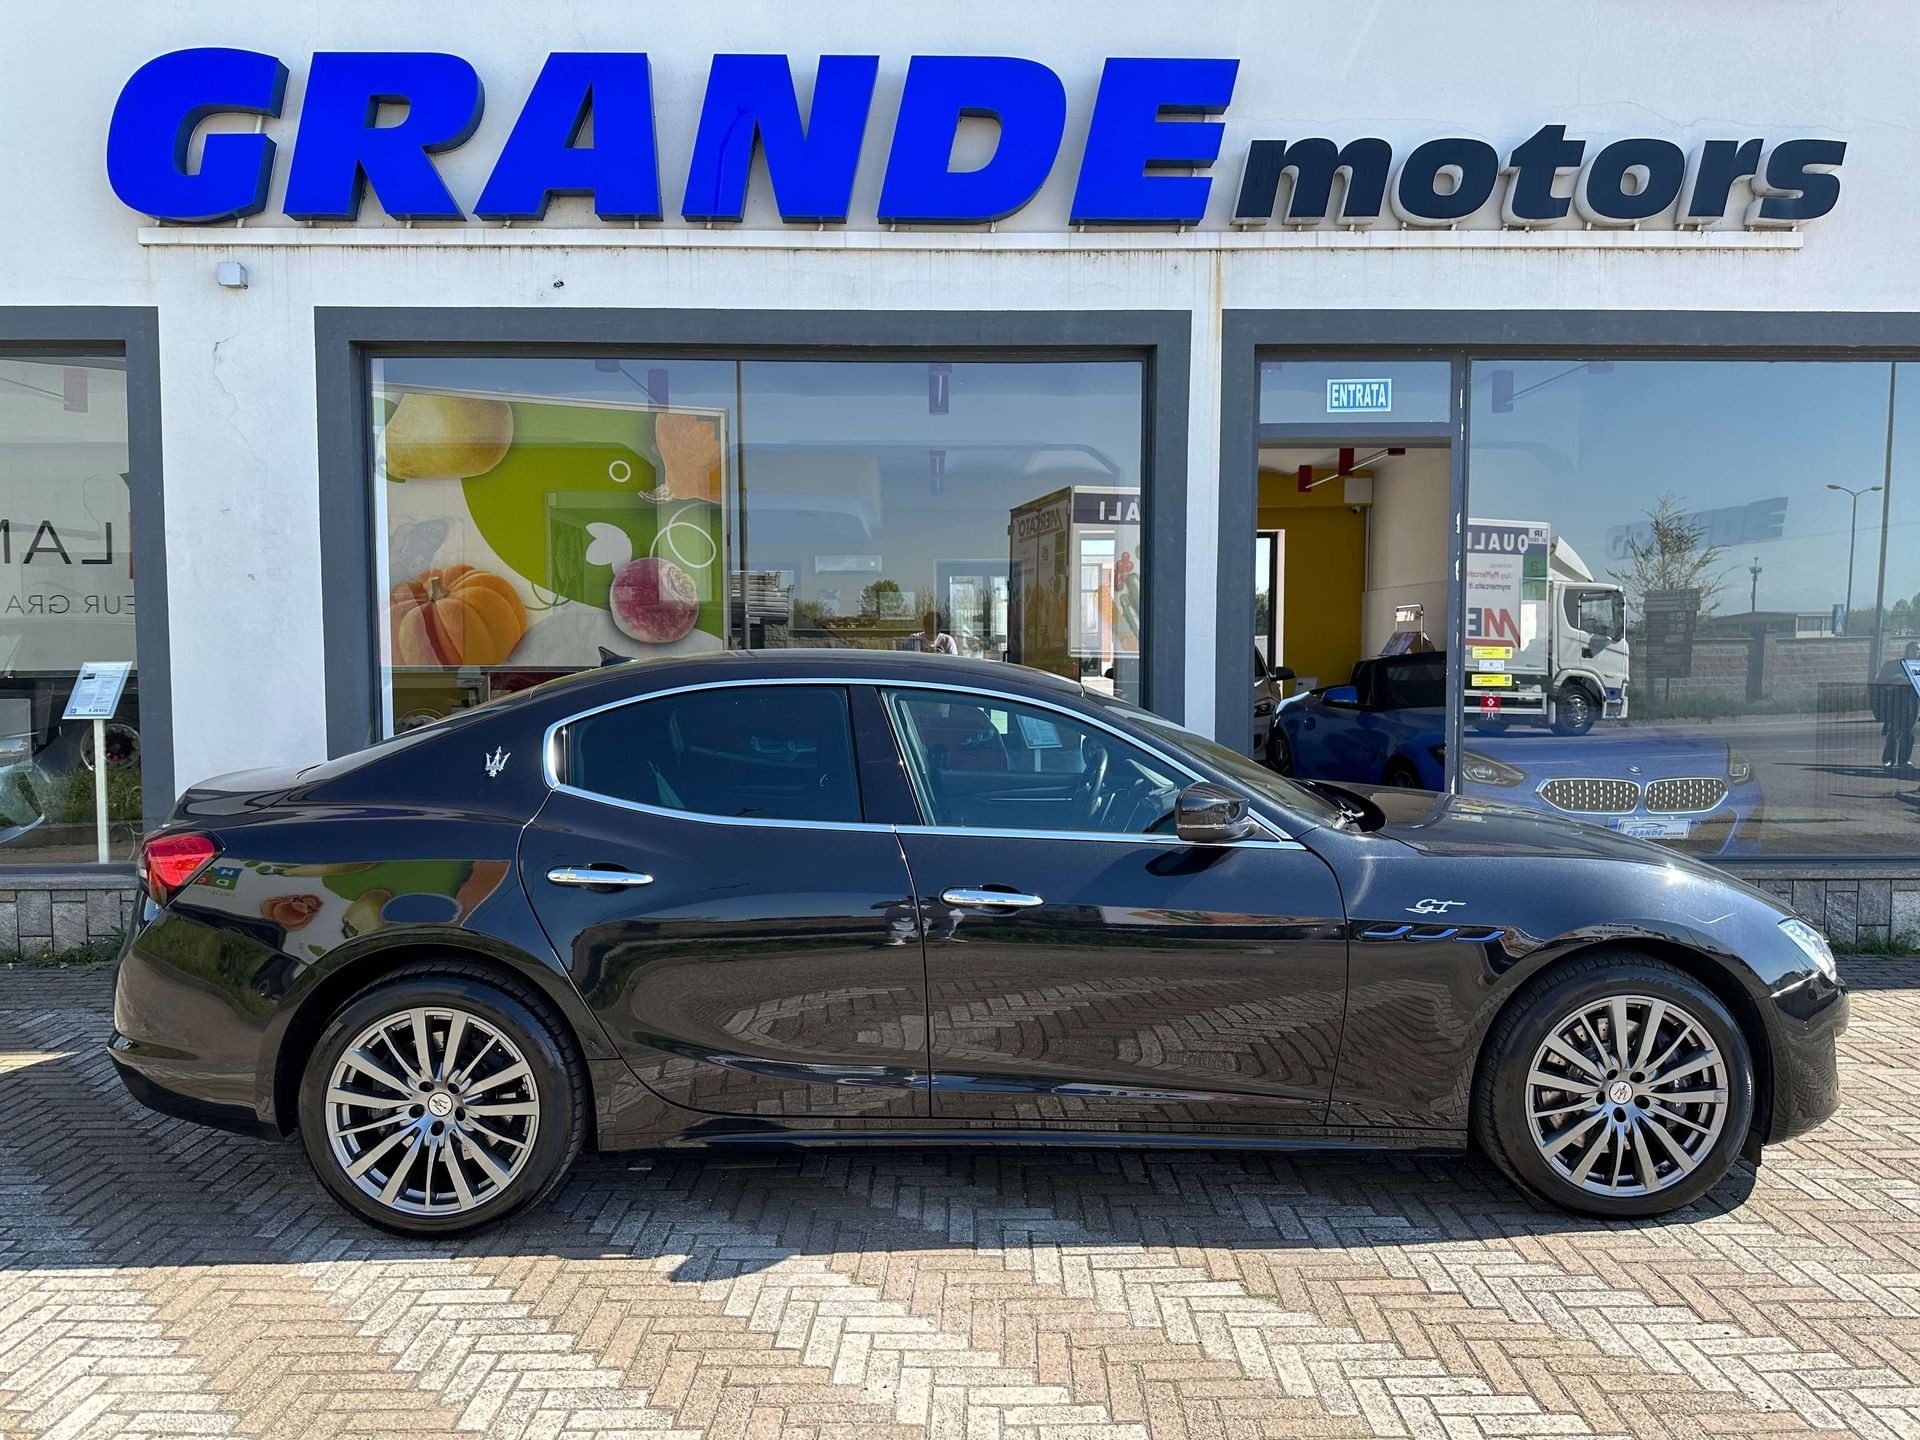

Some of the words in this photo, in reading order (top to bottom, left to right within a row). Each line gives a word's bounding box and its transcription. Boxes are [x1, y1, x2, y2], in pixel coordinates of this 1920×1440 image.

[106, 47, 1240, 226] GRANDE
[1232, 124, 1846, 226] motors
[1331, 383, 1387, 407] ENTRATA
[1404, 898, 1466, 914] GT
